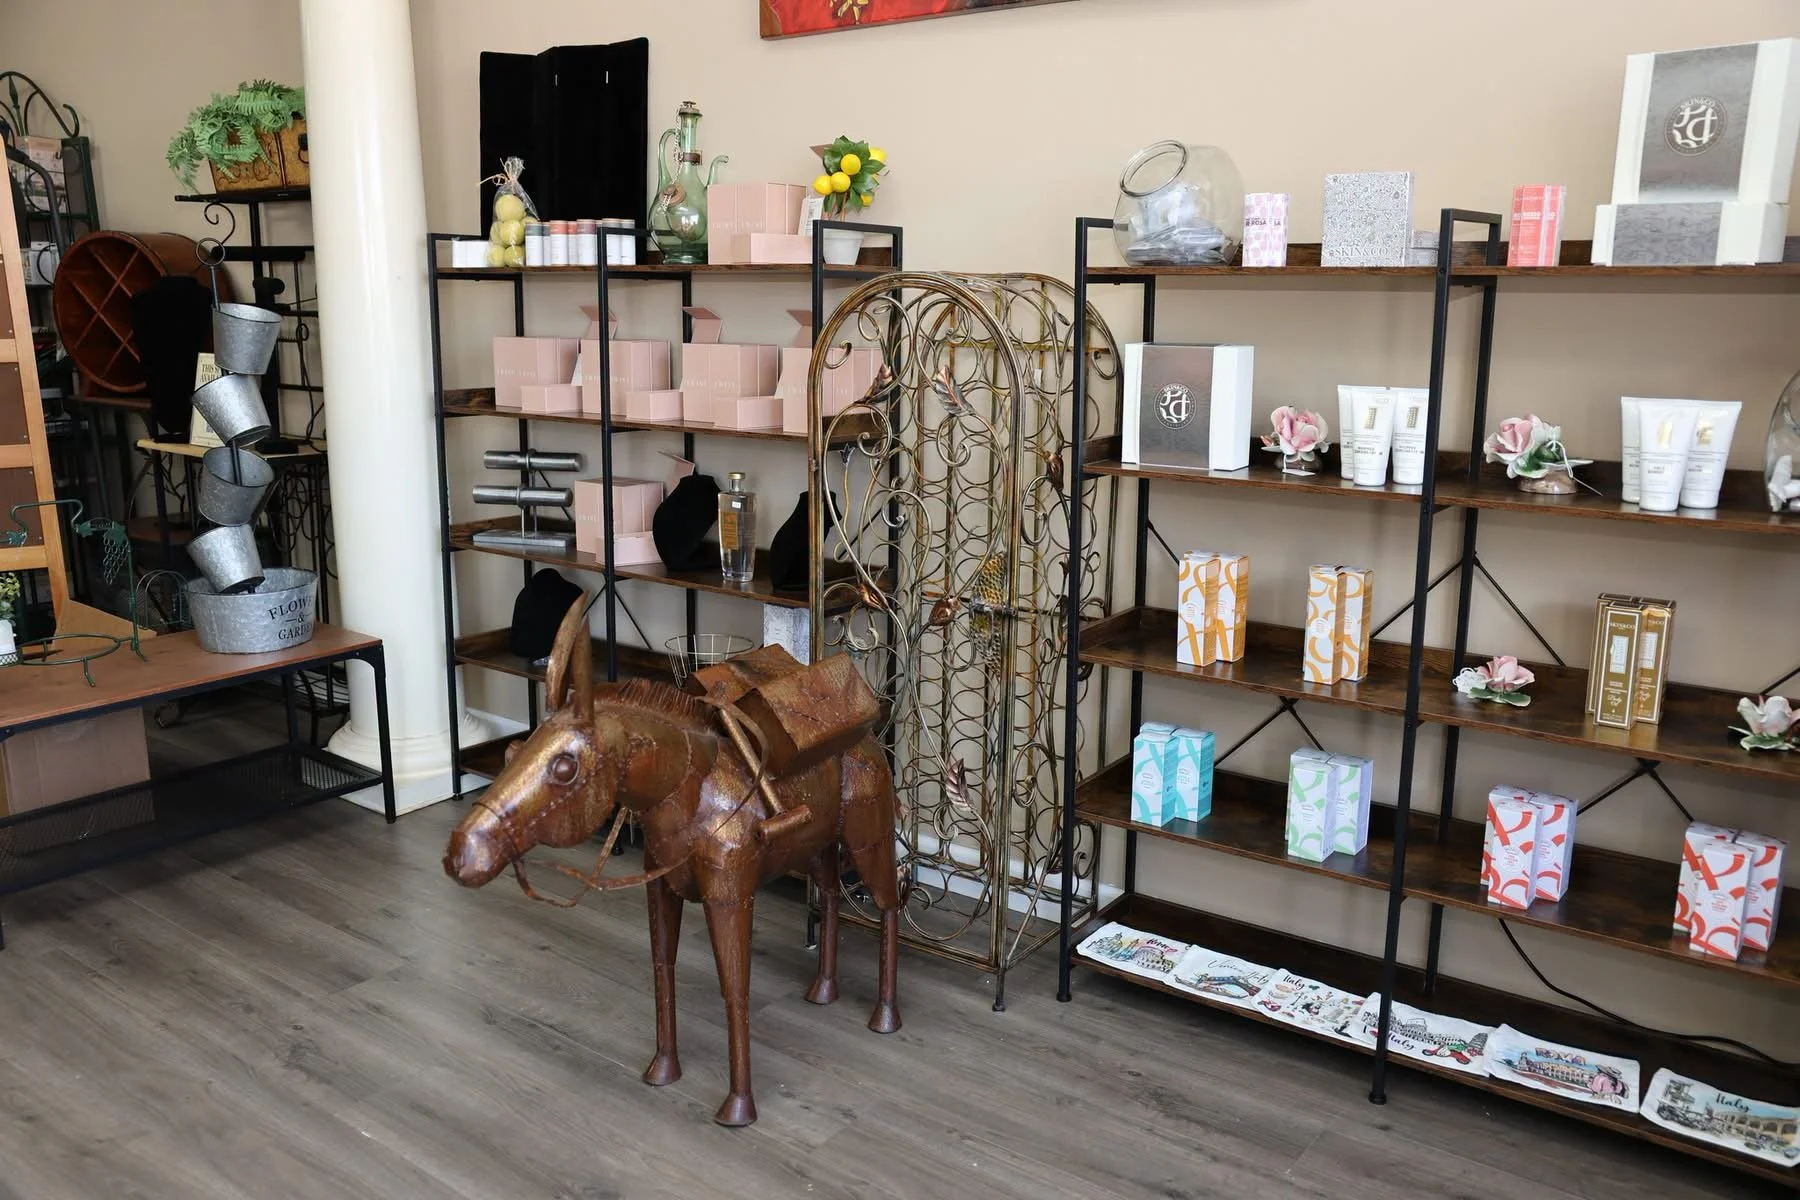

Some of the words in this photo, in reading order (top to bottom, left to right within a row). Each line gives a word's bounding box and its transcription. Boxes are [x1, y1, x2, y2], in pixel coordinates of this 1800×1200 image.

[1335, 247, 1388, 257] SKIN&CO
[1282, 975, 1306, 990] Italy
[1388, 1031, 1415, 1051] Italy
[1715, 1093, 1751, 1113] Italy
